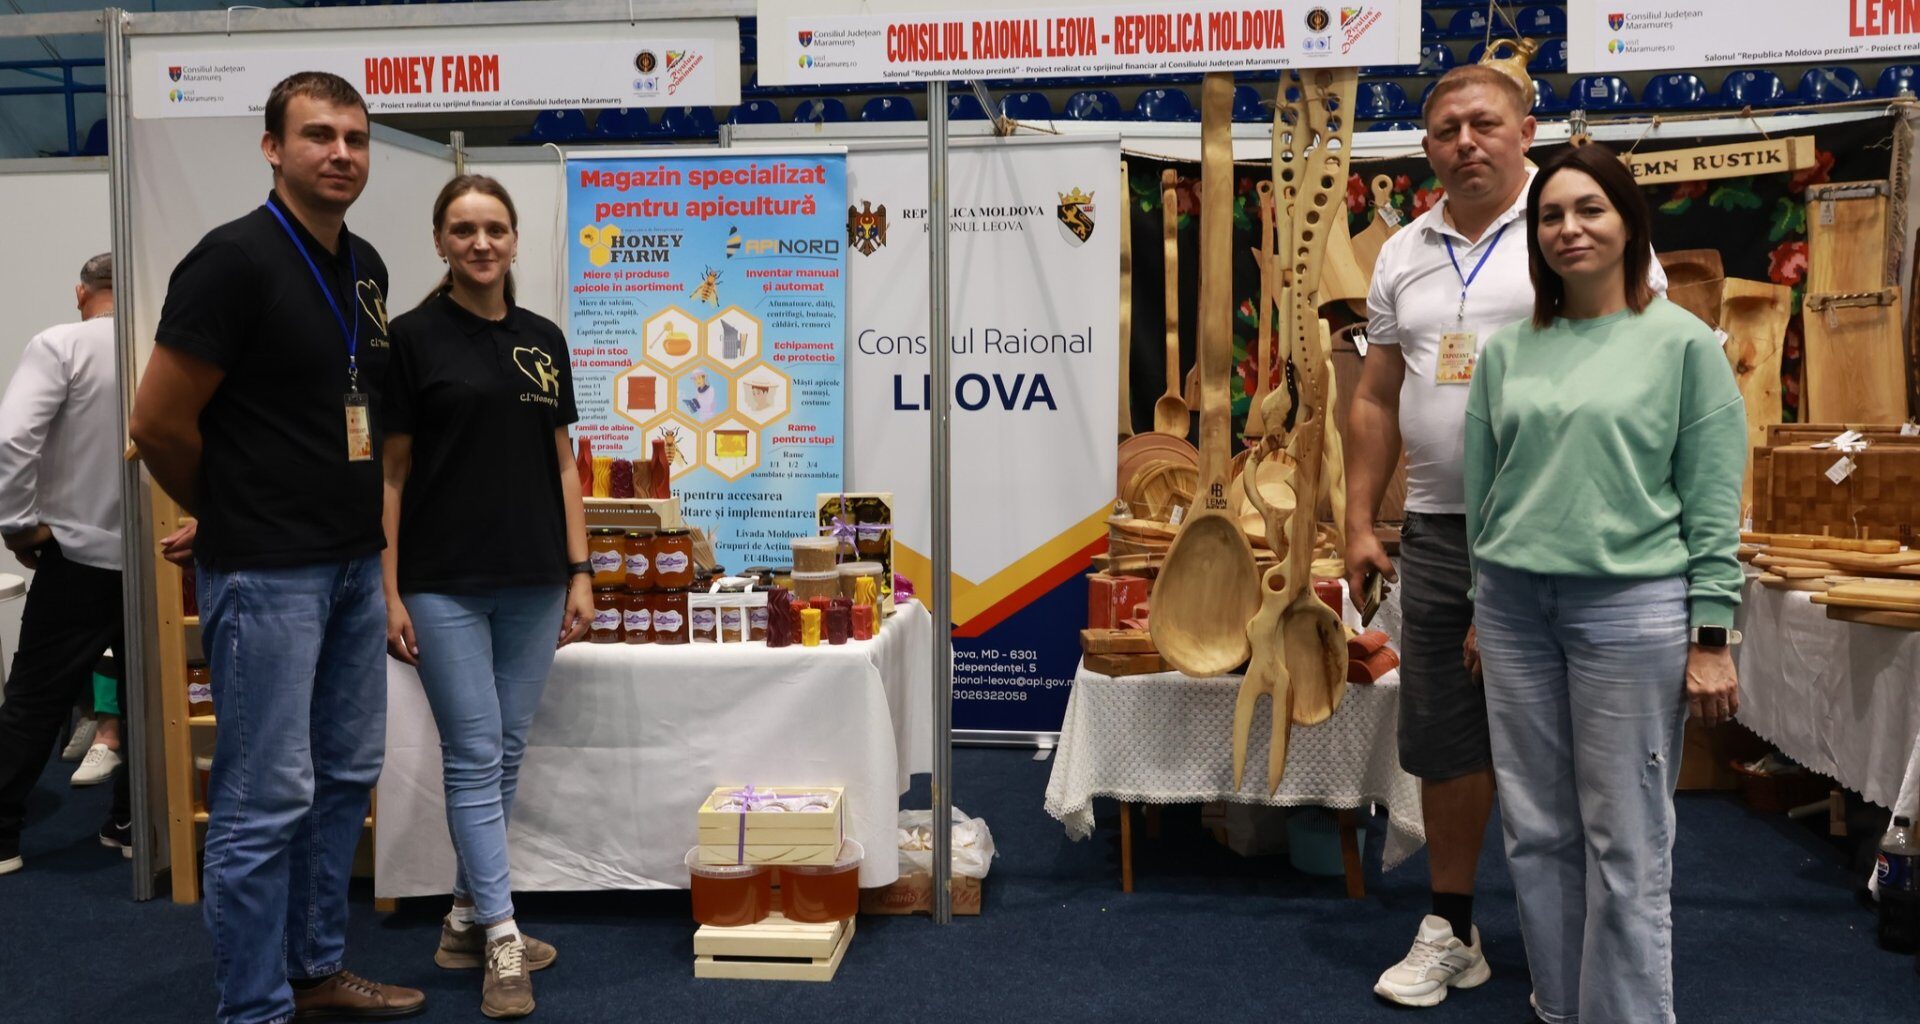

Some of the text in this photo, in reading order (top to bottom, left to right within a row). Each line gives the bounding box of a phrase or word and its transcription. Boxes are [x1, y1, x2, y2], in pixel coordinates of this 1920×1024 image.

[1625, 11, 1662, 21] Consiliul
[813, 30, 846, 39] Consiliul
[887, 22, 968, 63] CONSILIUL
[972, 19, 1042, 60] RAIONAL
[1046, 16, 1097, 58] LEOVA
[1115, 12, 1203, 55] REPUBLICA
[1208, 8, 1285, 52] MOLDOVA
[1704, 53, 1736, 62] Salonul
[1785, 48, 1822, 57] Moldova
[1904, 42, 1920, 50] real
[183, 66, 213, 74] Consiliul
[883, 70, 910, 78] Salonul
[952, 68, 984, 76] Moldova
[1026, 66, 1052, 74] Proiect
[1053, 65, 1081, 73] realizat
[1093, 62, 1123, 73] sprijinul
[1125, 61, 1158, 70] financiar
[1159, 61, 1166, 69] al
[1168, 60, 1208, 69] Consiliului
[1245, 58, 1289, 67] Maramureș
[365, 54, 500, 95] HONEY FARM
[381, 101, 404, 109] Proiect
[442, 99, 470, 109] sprijinul
[471, 99, 502, 107] financiar
[511, 98, 547, 106] Consiliului
[1632, 149, 1781, 178] EMN RUSTIK
[580, 164, 826, 192] Magazin specializat
[595, 194, 817, 222] pentru apicultură
[978, 206, 1044, 217] MOLDOVA
[982, 220, 1023, 232] LEOVA
[611, 235, 683, 248] HONEY
[745, 239, 839, 254] APINORD
[610, 250, 669, 262] FARM
[584, 270, 670, 281] Miere și produse
[746, 268, 839, 278] Inventar manual
[573, 283, 609, 294] apicole
[625, 282, 684, 292] asortiment
[763, 282, 824, 293] și automat
[774, 341, 834, 351] Echipament
[858, 326, 1092, 355] Consul Raional
[608, 348, 628, 356] stoc
[773, 352, 786, 361] de
[589, 359, 632, 368] comandă
[815, 380, 840, 388] apicole
[589, 433, 629, 441] certificate
[772, 435, 835, 445] pentru stupi
[750, 471, 786, 479] asamblate
[795, 471, 840, 479] neasamblate
[684, 491, 723, 502] pentru
[727, 492, 782, 502] accesarea
[715, 507, 724, 519] și
[728, 507, 816, 520] implementarea
[736, 529, 808, 539] Livada Moldovei
[715, 541, 762, 551] Grupuri de
[952, 650, 1037, 660] eova, MD 6301
[952, 662, 1037, 675] ndependenței, 5
[952, 690, 1028, 701] 3026322058
